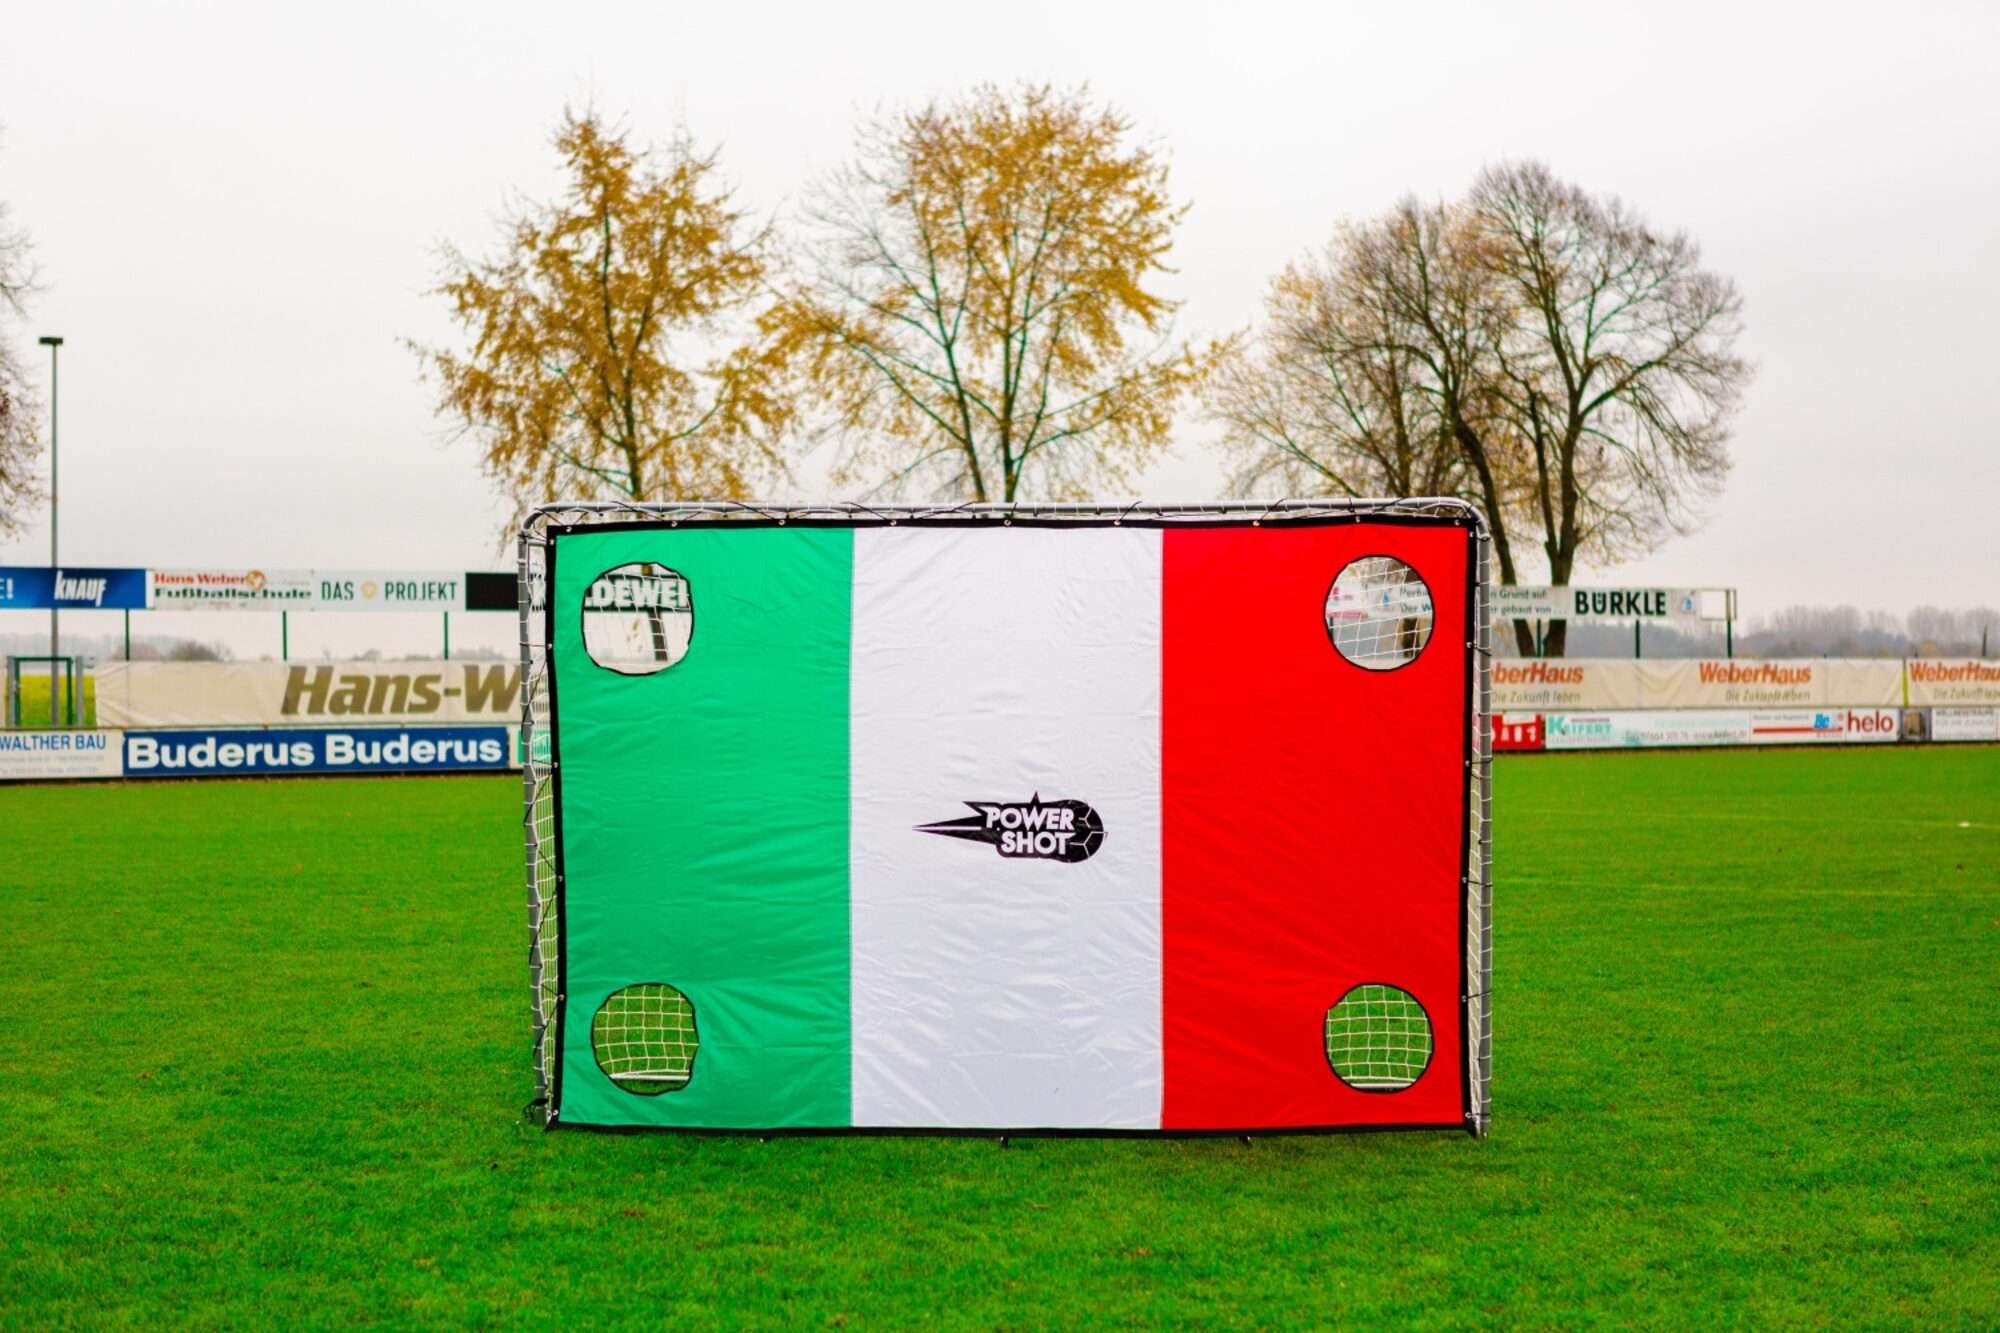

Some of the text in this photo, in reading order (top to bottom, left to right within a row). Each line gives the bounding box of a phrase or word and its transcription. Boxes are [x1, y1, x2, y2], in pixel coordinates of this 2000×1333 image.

[54, 570, 107, 607] KNAUF
[155, 573, 246, 585] Hans Weber
[321, 581, 457, 600] DAS PROJEKT
[1575, 590, 1666, 615] BÜRKLE
[1491, 661, 1584, 683] berHaus
[1699, 661, 1812, 684] WeberHaus
[1847, 709, 1894, 733] helo
[0, 734, 106, 751] WALTHER BAU
[128, 733, 502, 769] Buderus Buderus
[979, 804, 1076, 832] POWER
[1001, 831, 1076, 855] SHOT
